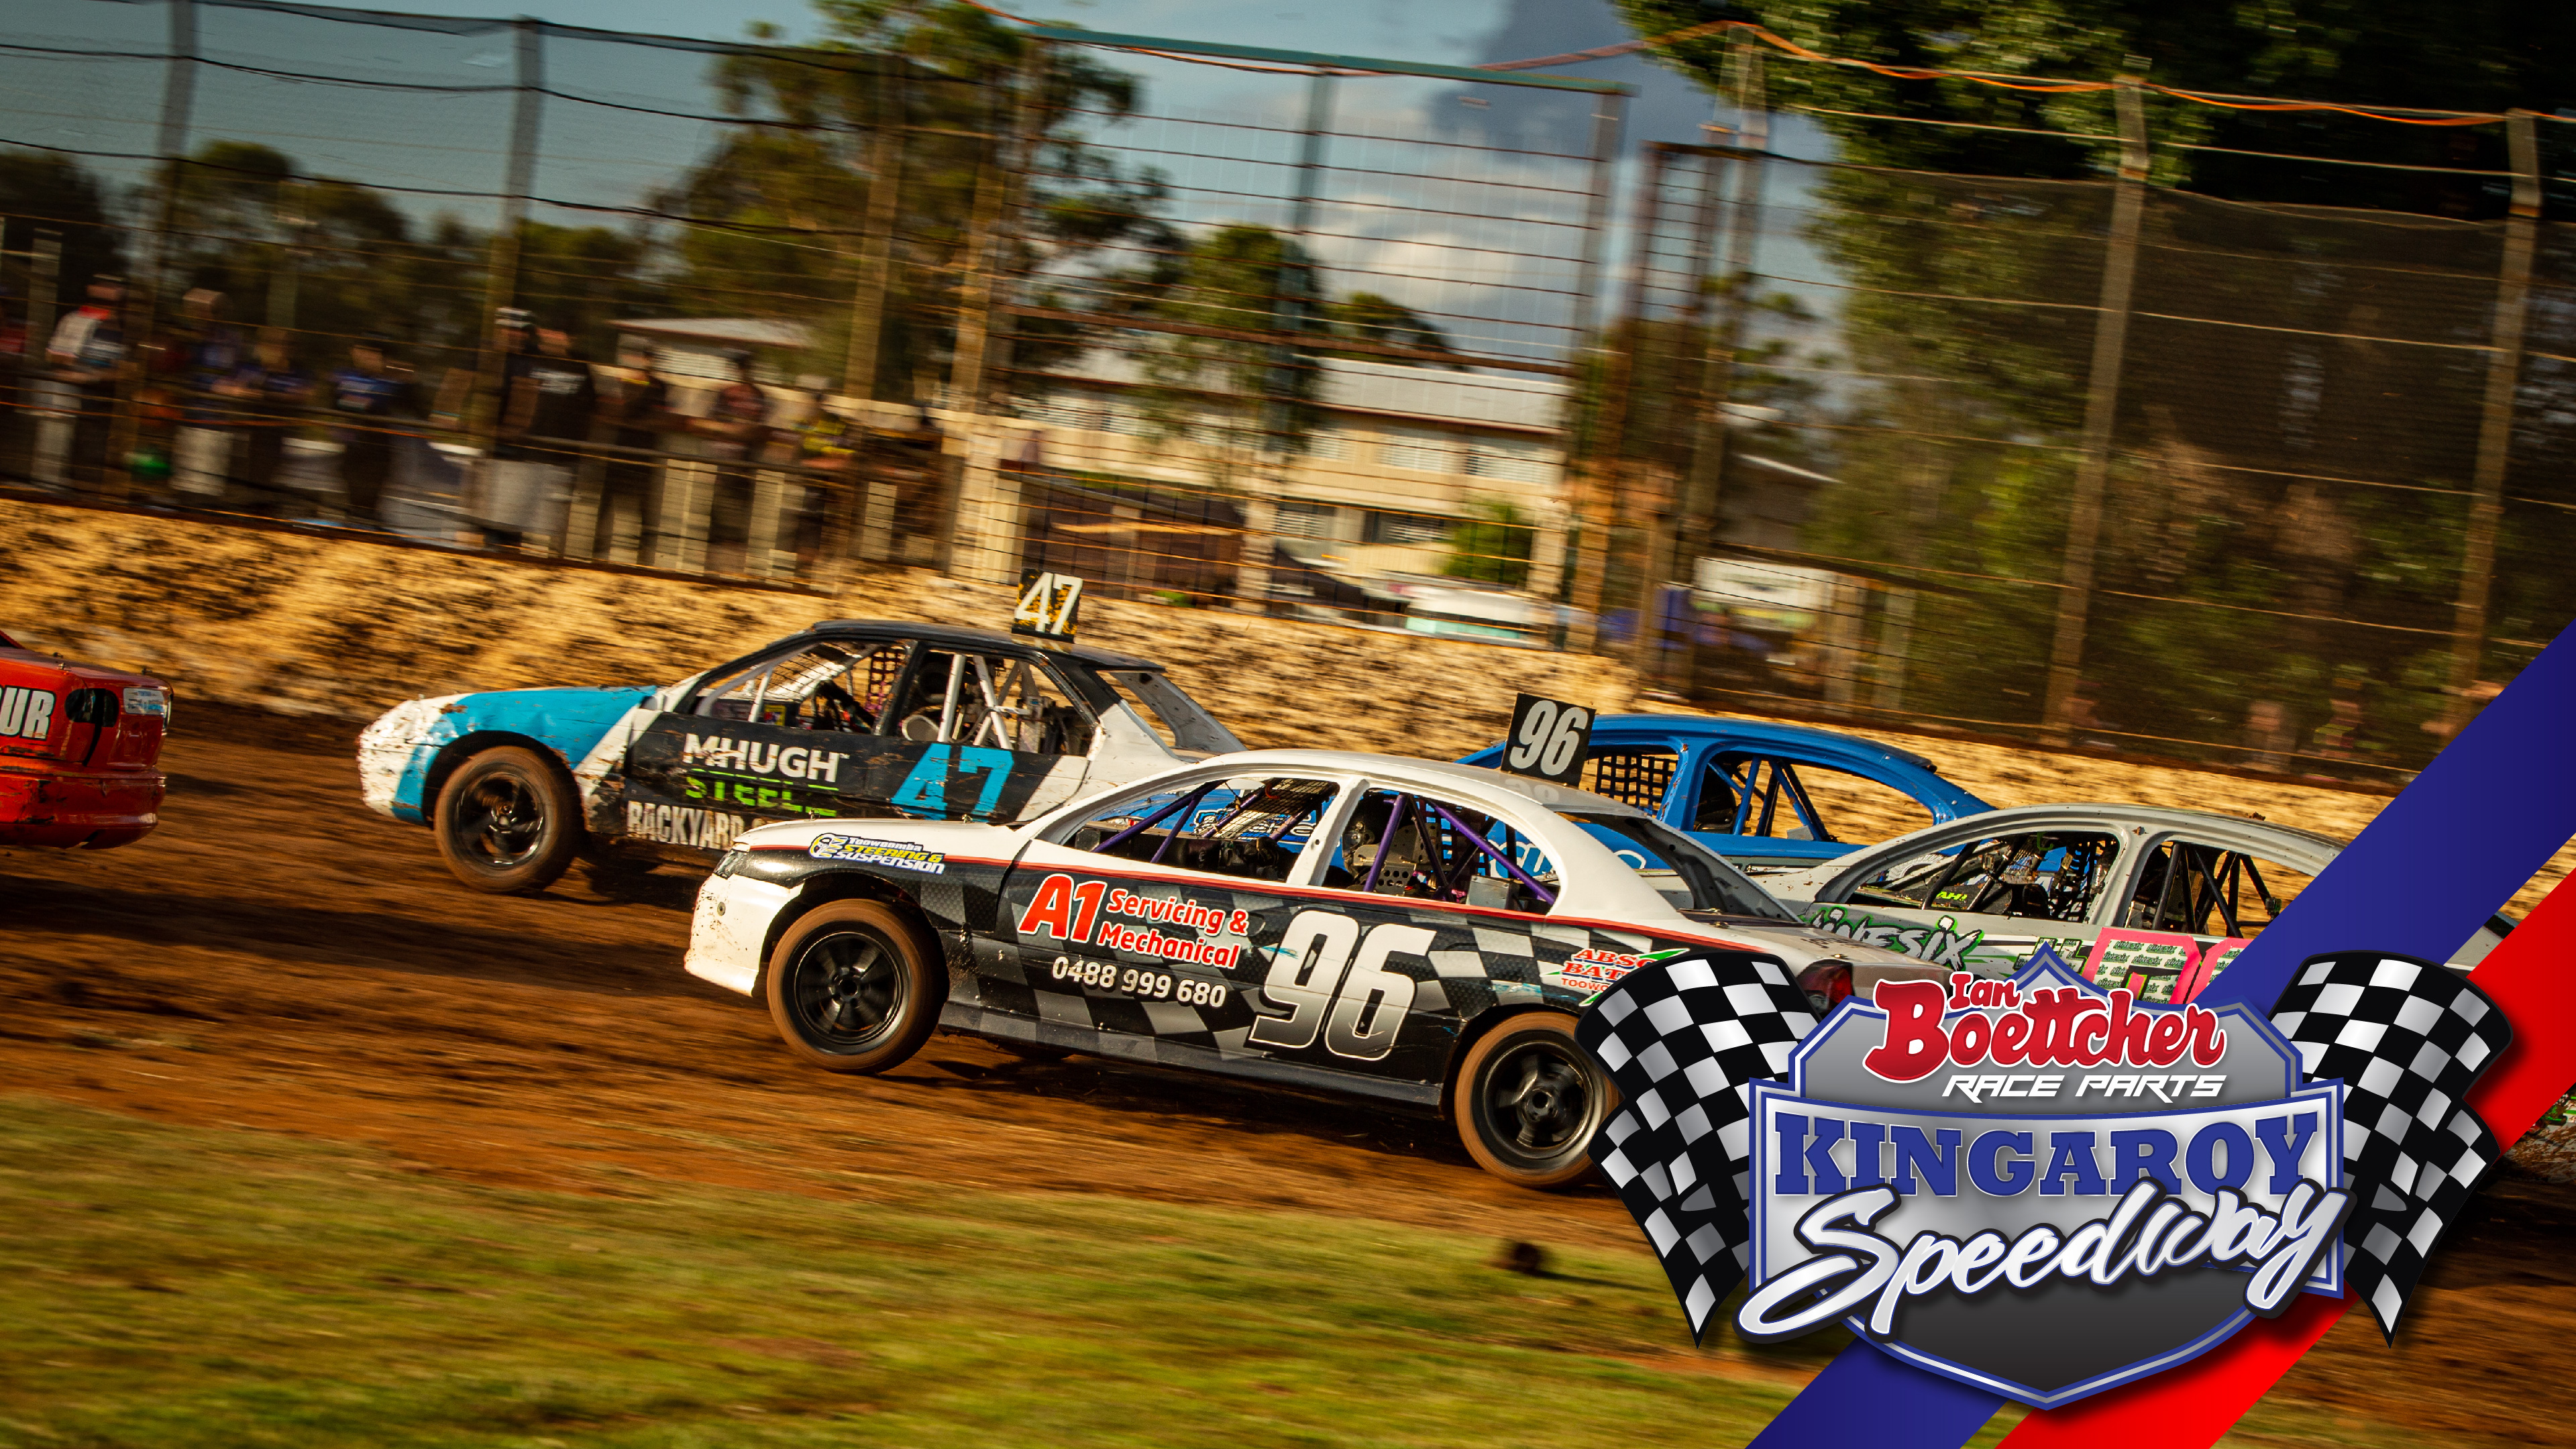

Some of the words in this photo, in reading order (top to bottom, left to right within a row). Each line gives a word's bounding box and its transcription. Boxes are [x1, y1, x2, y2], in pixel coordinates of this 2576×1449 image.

[1014, 572, 1083, 635] 47
[0, 686, 56, 740] UR
[1509, 700, 1589, 775] 96
[891, 743, 1014, 822] 47
[833, 851, 946, 875] SUSPENSION
[845, 845, 926, 861] STEERING
[928, 853, 944, 863] &
[849, 837, 923, 851] Toowoomba
[1018, 873, 1108, 943] A1
[1107, 888, 1226, 936] Servicing
[1227, 908, 1249, 936] &
[1097, 921, 1241, 970] Mechanical
[1052, 956, 1118, 989] 0488
[1121, 969, 1171, 998] 999
[1176, 979, 1227, 1008] 680
[1248, 910, 1437, 1061] 96
